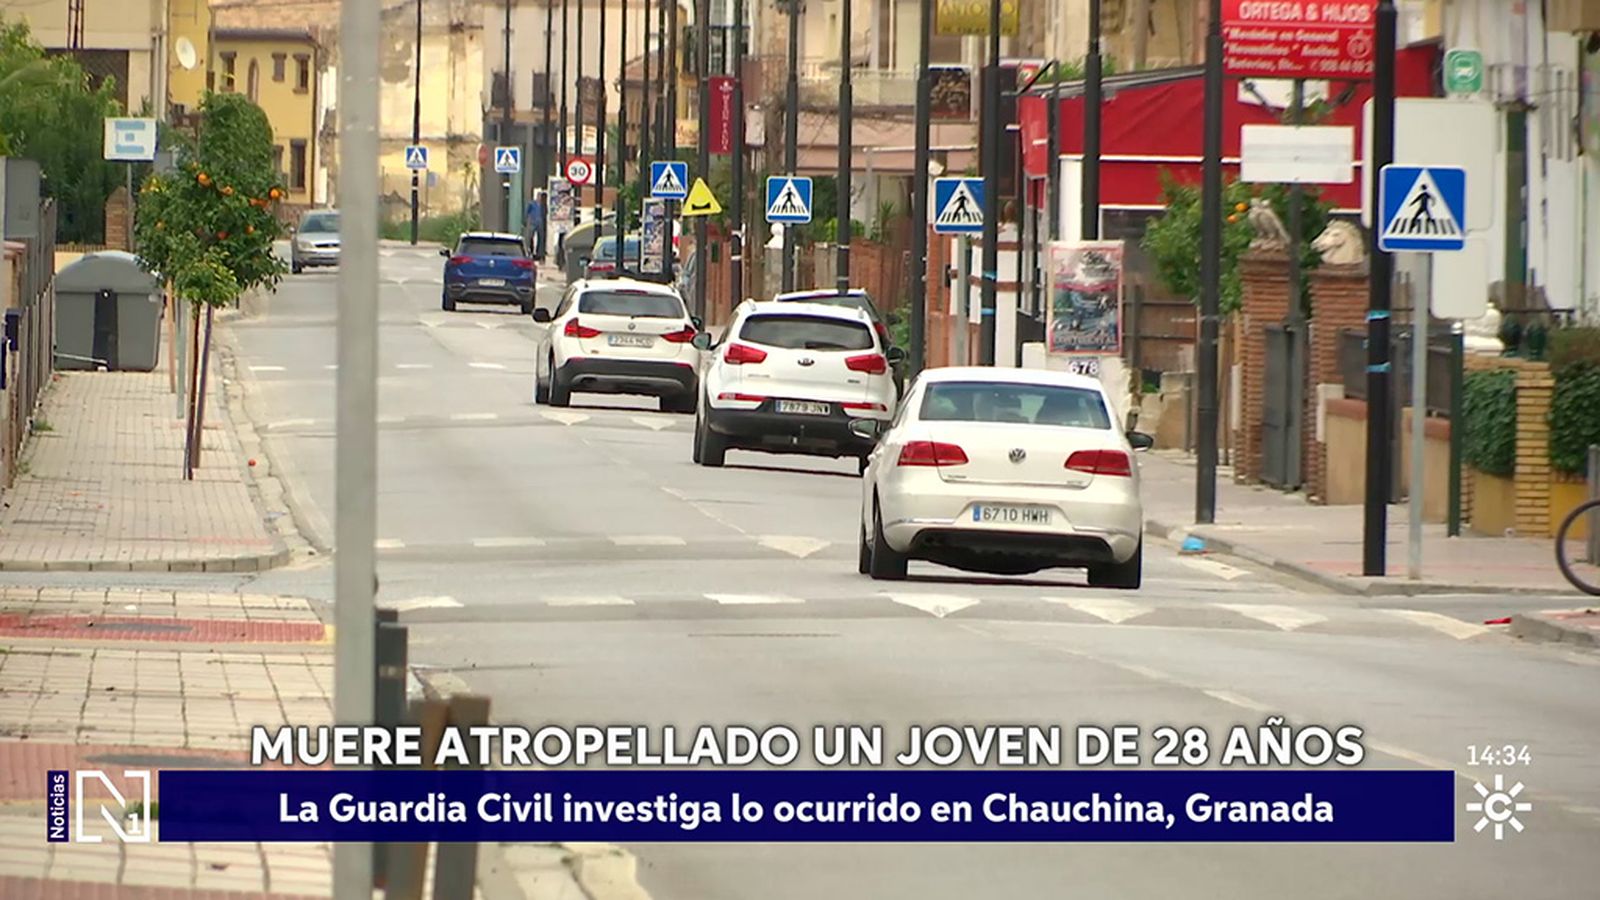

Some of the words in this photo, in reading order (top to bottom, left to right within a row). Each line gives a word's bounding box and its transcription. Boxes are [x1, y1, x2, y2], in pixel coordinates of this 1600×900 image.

[1239, 2, 1303, 20] ORTEGA
[1305, 3, 1319, 21] &
[1322, 3, 1371, 22] HIJOS
[570, 166, 586, 176] 30
[983, 506, 1018, 521] 6710
[1022, 509, 1048, 523] HWH
